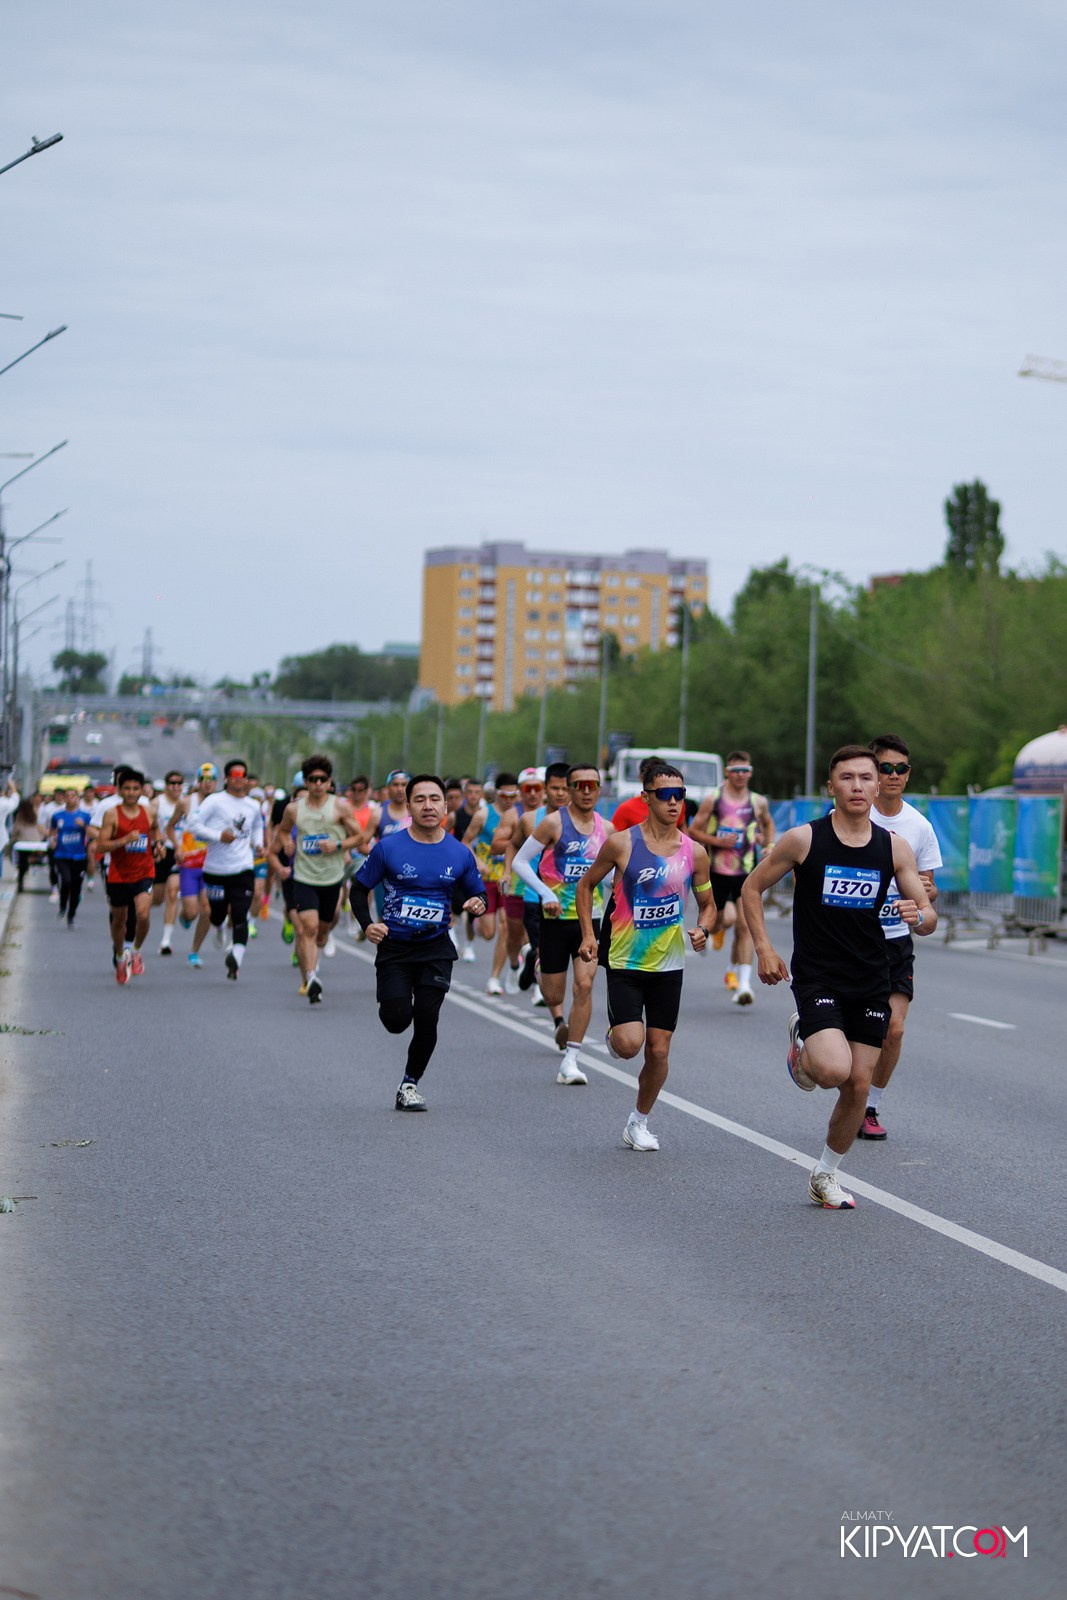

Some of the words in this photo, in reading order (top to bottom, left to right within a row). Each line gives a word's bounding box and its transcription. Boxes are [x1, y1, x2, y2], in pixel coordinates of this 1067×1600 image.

[569, 866, 590, 875] 129
[830, 880, 872, 897] 1370
[406, 907, 439, 920] 1427
[640, 904, 674, 919] 1384
[881, 905, 900, 917] 90
